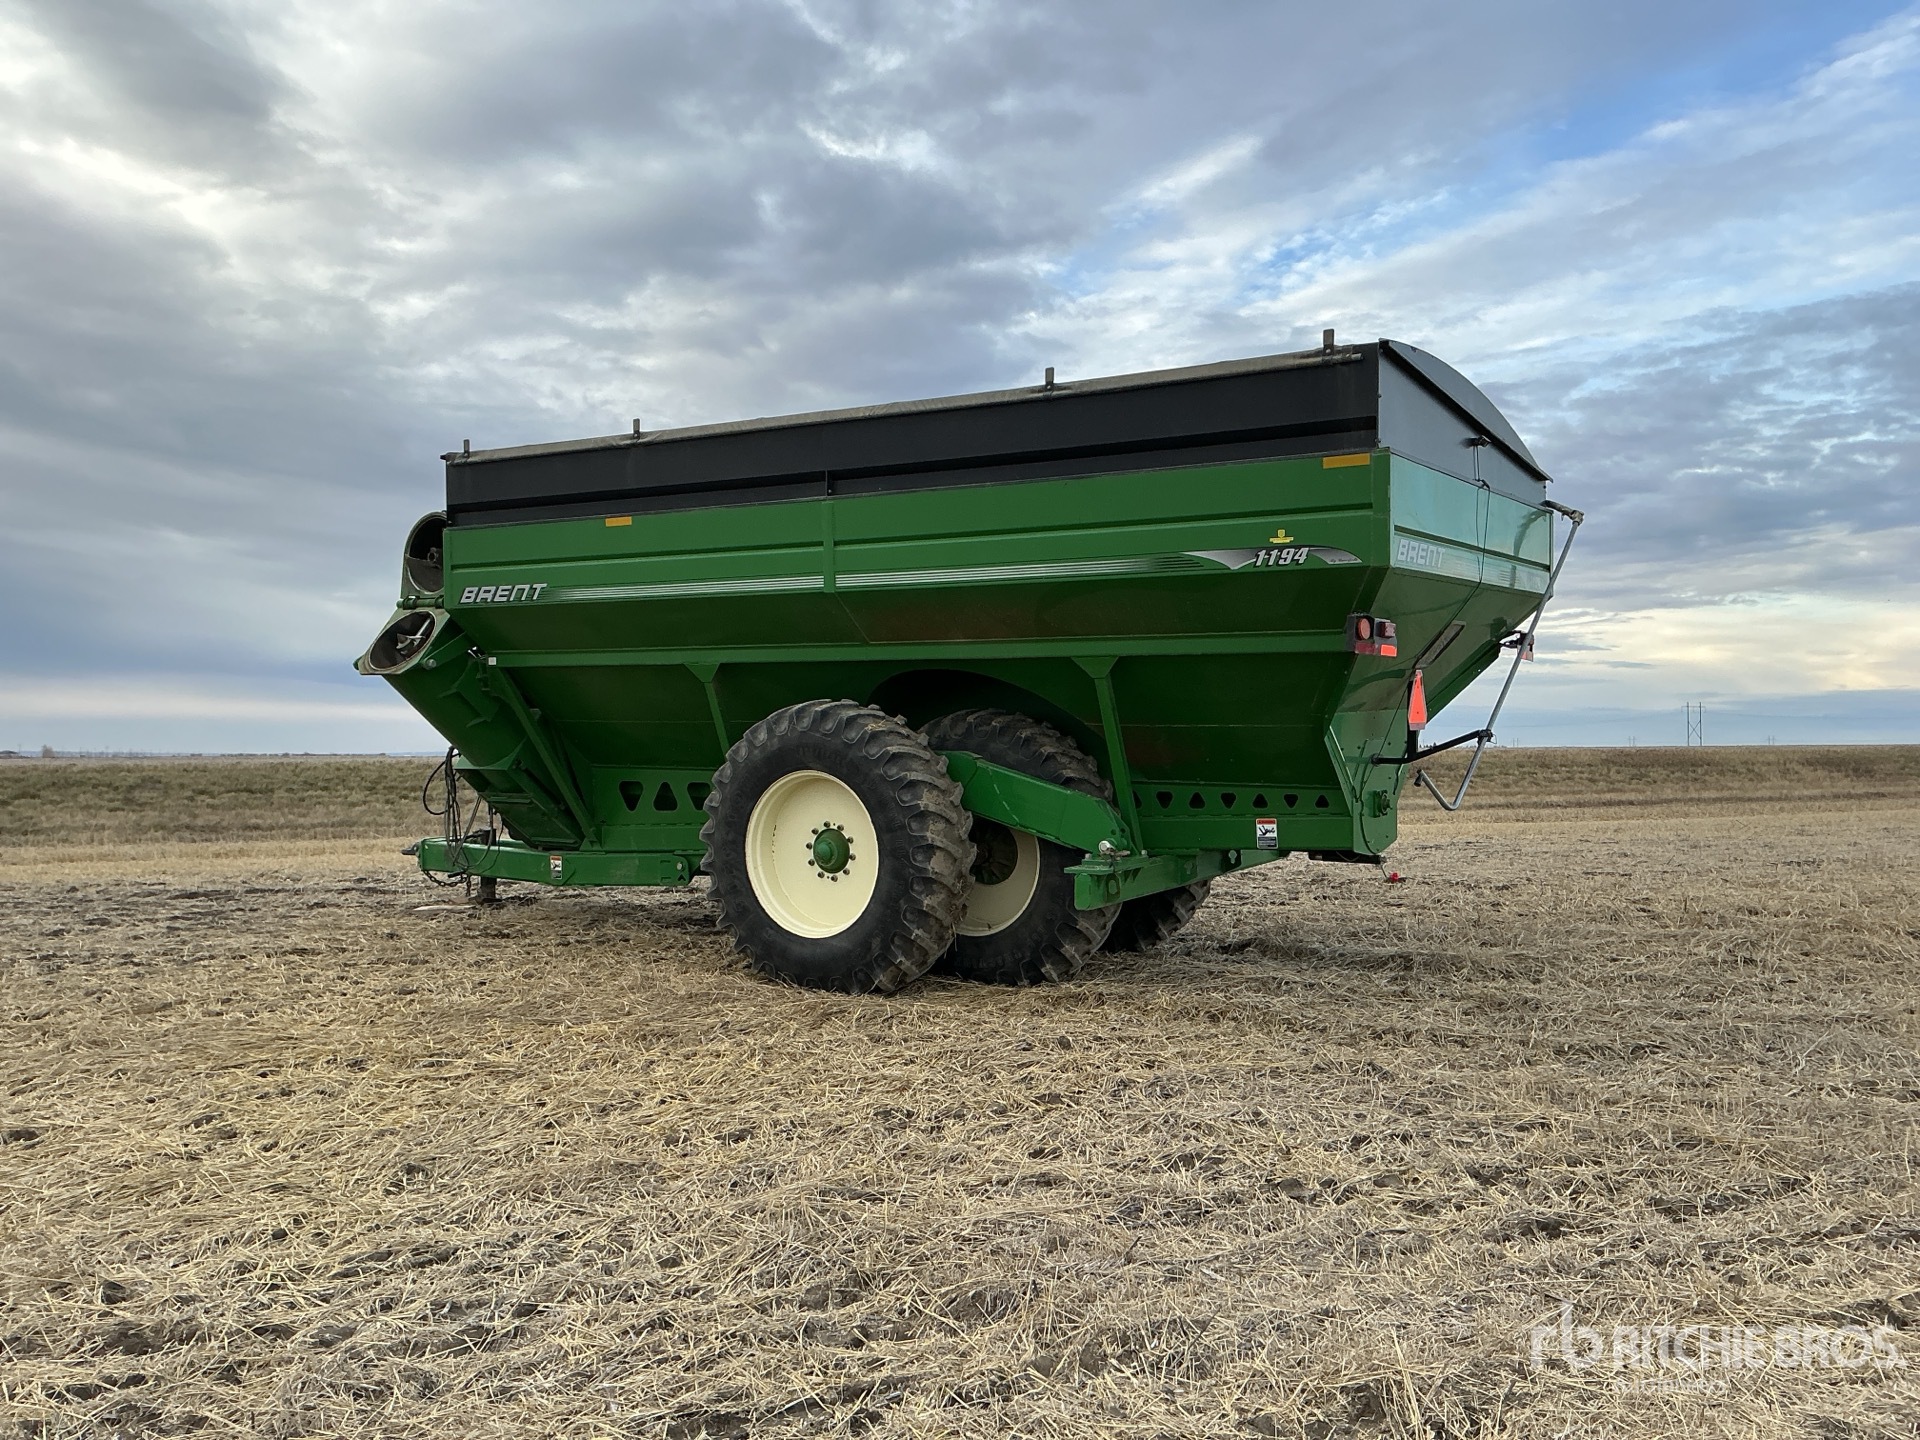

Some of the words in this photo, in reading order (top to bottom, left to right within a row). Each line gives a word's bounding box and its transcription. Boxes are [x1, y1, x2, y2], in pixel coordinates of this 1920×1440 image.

[1255, 547, 1309, 566] 1194
[1398, 538, 1445, 568] BRENT
[460, 583, 547, 603] BRENT
